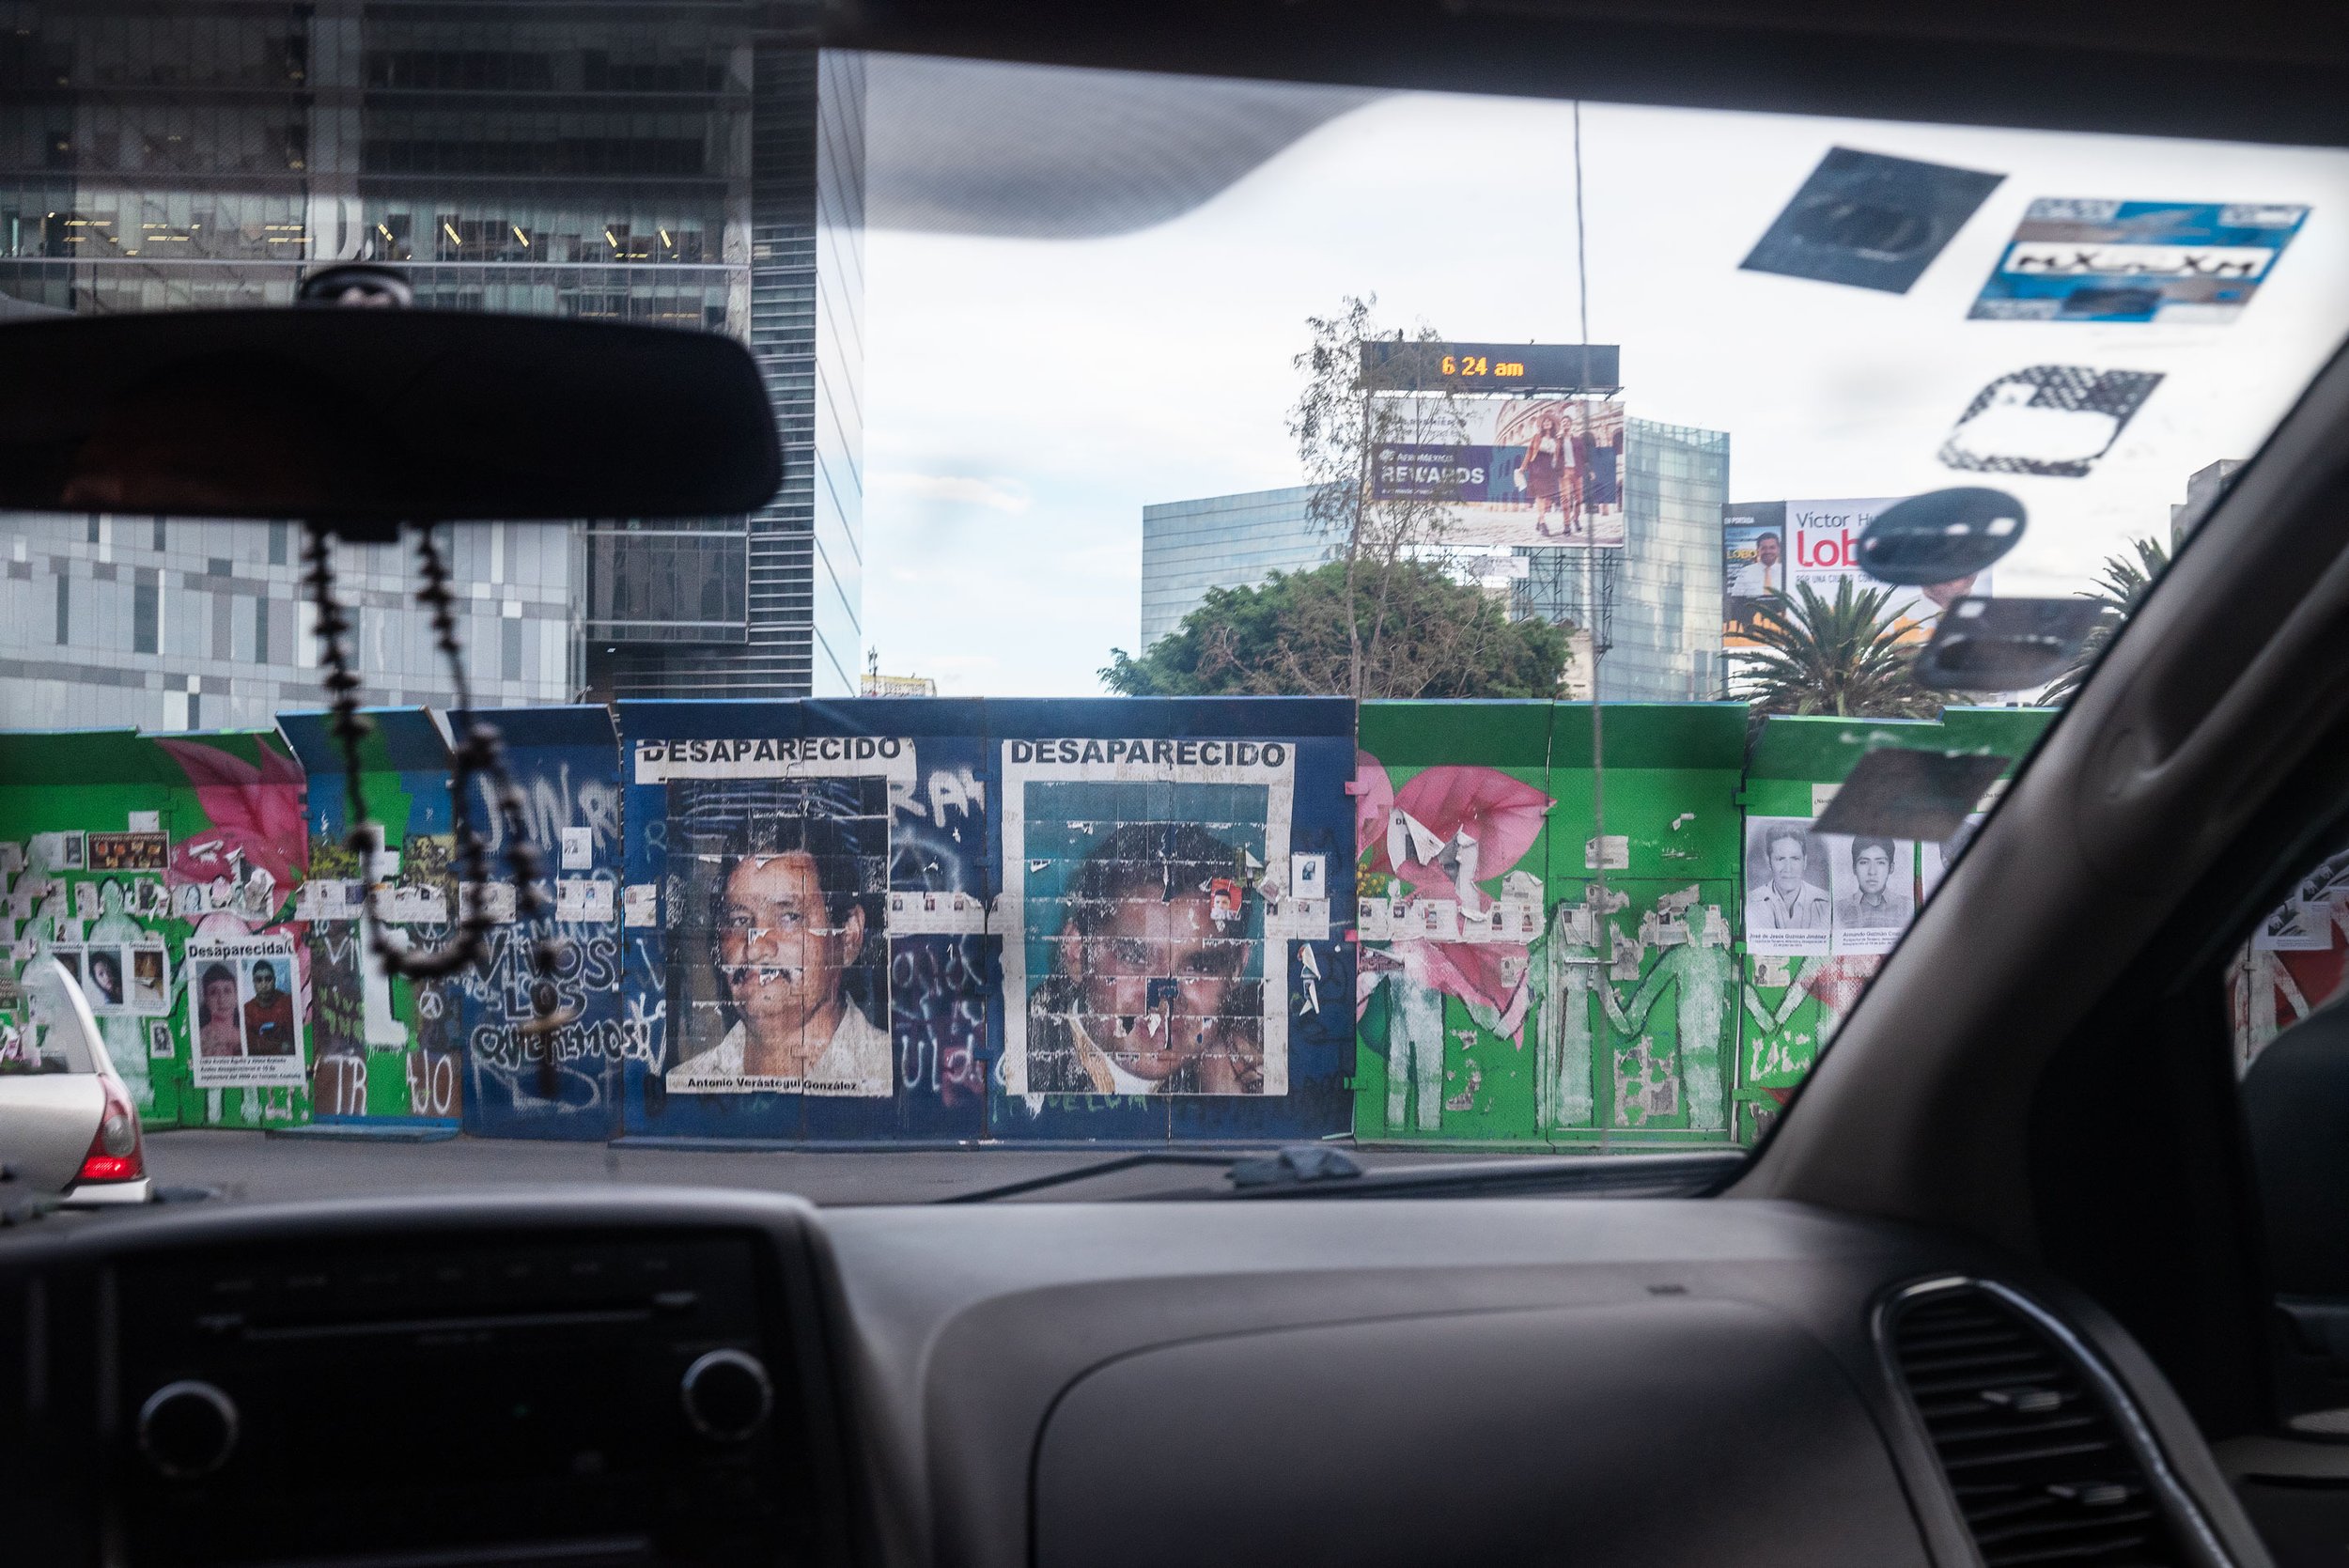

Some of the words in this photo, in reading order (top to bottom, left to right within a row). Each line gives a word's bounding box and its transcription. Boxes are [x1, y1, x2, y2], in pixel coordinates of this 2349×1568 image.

[1442, 356, 1455, 375] 6
[1461, 356, 1488, 376] 24
[1494, 363, 1524, 376] am
[1797, 512, 1850, 528] Víctor
[1797, 528, 1859, 567] Lob
[643, 738, 901, 763] DESAPARECIDO
[1011, 739, 1285, 768] DESAPARECIDO
[503, 980, 588, 1021] LOS
[688, 1078, 734, 1088] Antonio
[736, 1078, 801, 1093] Verástegui
[803, 1079, 857, 1090] González
